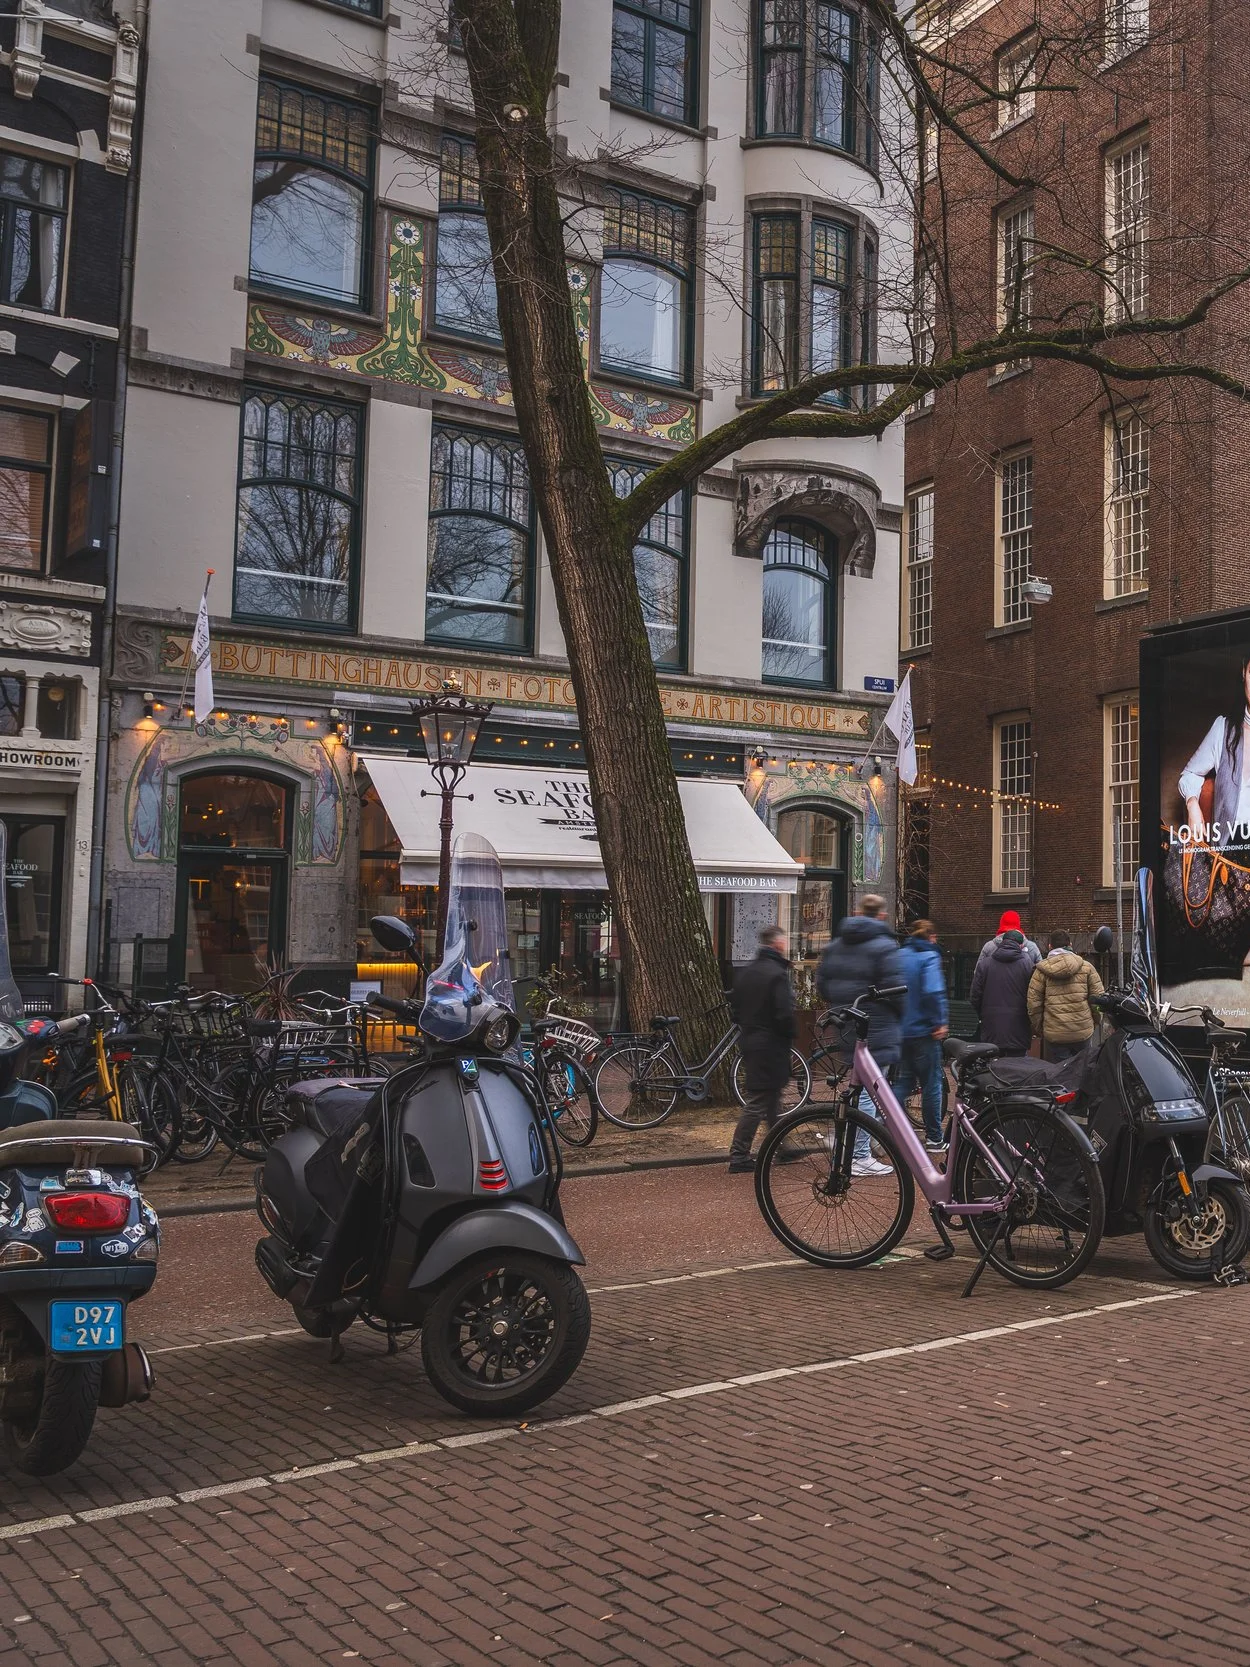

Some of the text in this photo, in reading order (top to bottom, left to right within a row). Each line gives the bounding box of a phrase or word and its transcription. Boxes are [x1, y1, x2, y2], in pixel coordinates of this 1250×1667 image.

[691, 694, 836, 731] ARTISTIQUE
[0, 752, 80, 767] HOWROOM
[562, 808, 595, 820] BA
[1169, 821, 1221, 845] LOUIS
[77, 840, 88, 851] 13
[5, 863, 38, 871] EAFOOD
[714, 876, 757, 887] SEAFOOD
[759, 878, 778, 888] BAR
[1213, 1008, 1220, 1016] Le
[1221, 1007, 1247, 1018] Neverfull
[75, 1306, 115, 1324] D97
[76, 1328, 115, 1345] 2VJ
